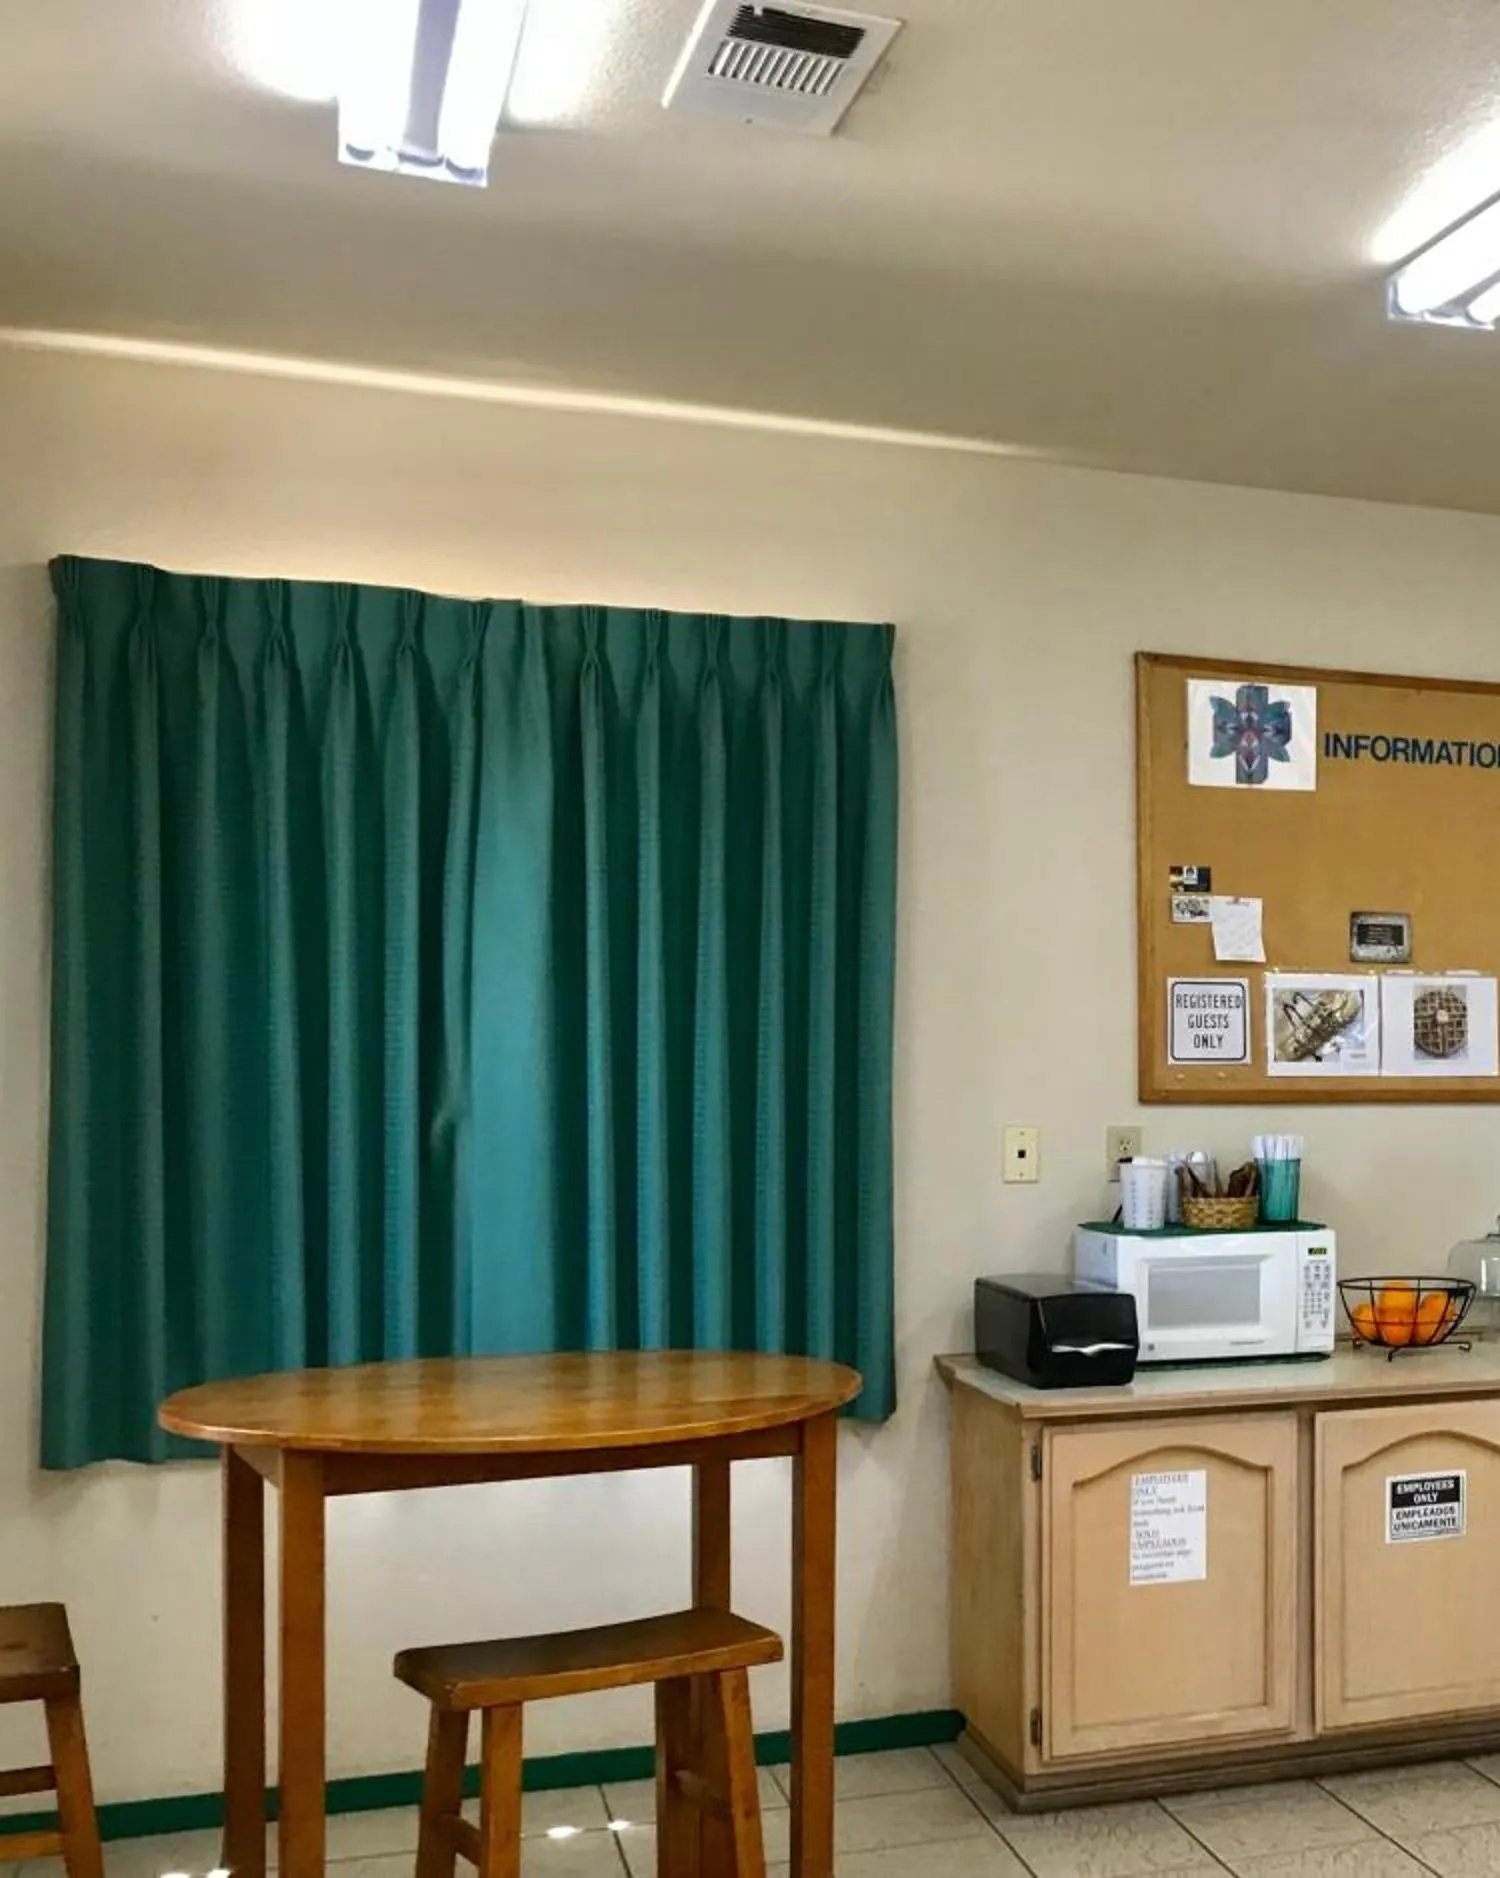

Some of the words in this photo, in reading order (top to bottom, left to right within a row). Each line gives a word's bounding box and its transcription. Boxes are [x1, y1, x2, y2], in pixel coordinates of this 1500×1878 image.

[1175, 993, 1243, 1009] REGISTERED
[1187, 1013, 1229, 1029] GUESTS
[1193, 1034, 1224, 1049] ONLY
[1396, 1479, 1455, 1494] EMPLOYEES
[1413, 1492, 1439, 1504] ONLY
[1395, 1505, 1455, 1520] EMPLEADOS
[1393, 1517, 1456, 1531] UNICAMENTE
